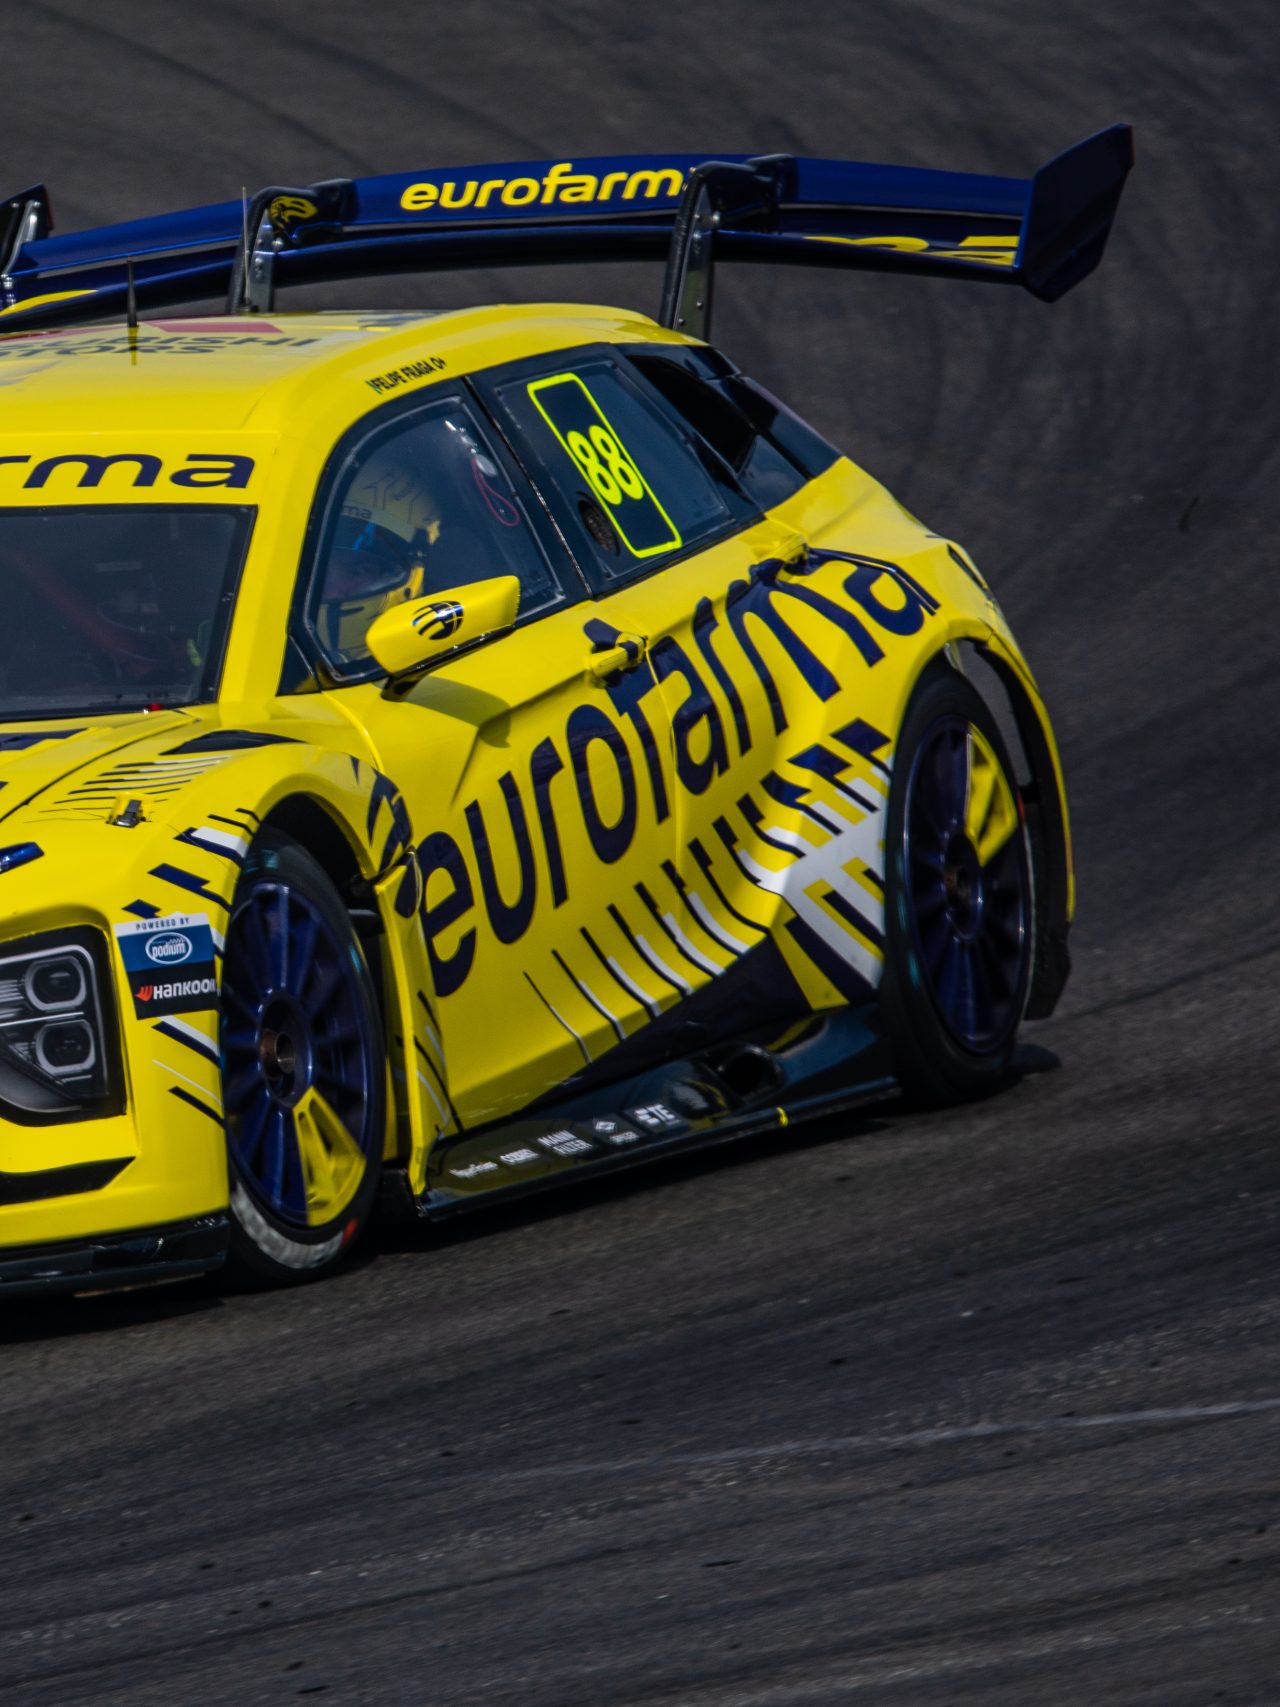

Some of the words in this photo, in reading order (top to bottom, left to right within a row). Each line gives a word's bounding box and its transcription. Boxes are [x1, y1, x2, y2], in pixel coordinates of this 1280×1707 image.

[400, 163, 689, 211] eurofarm
[400, 360, 439, 381] FRAGA
[567, 425, 644, 505] 88
[420, 546, 940, 998] eurofarma
[135, 919, 177, 931] POWERED
[180, 917, 190, 925] BY
[151, 941, 187, 959] podium
